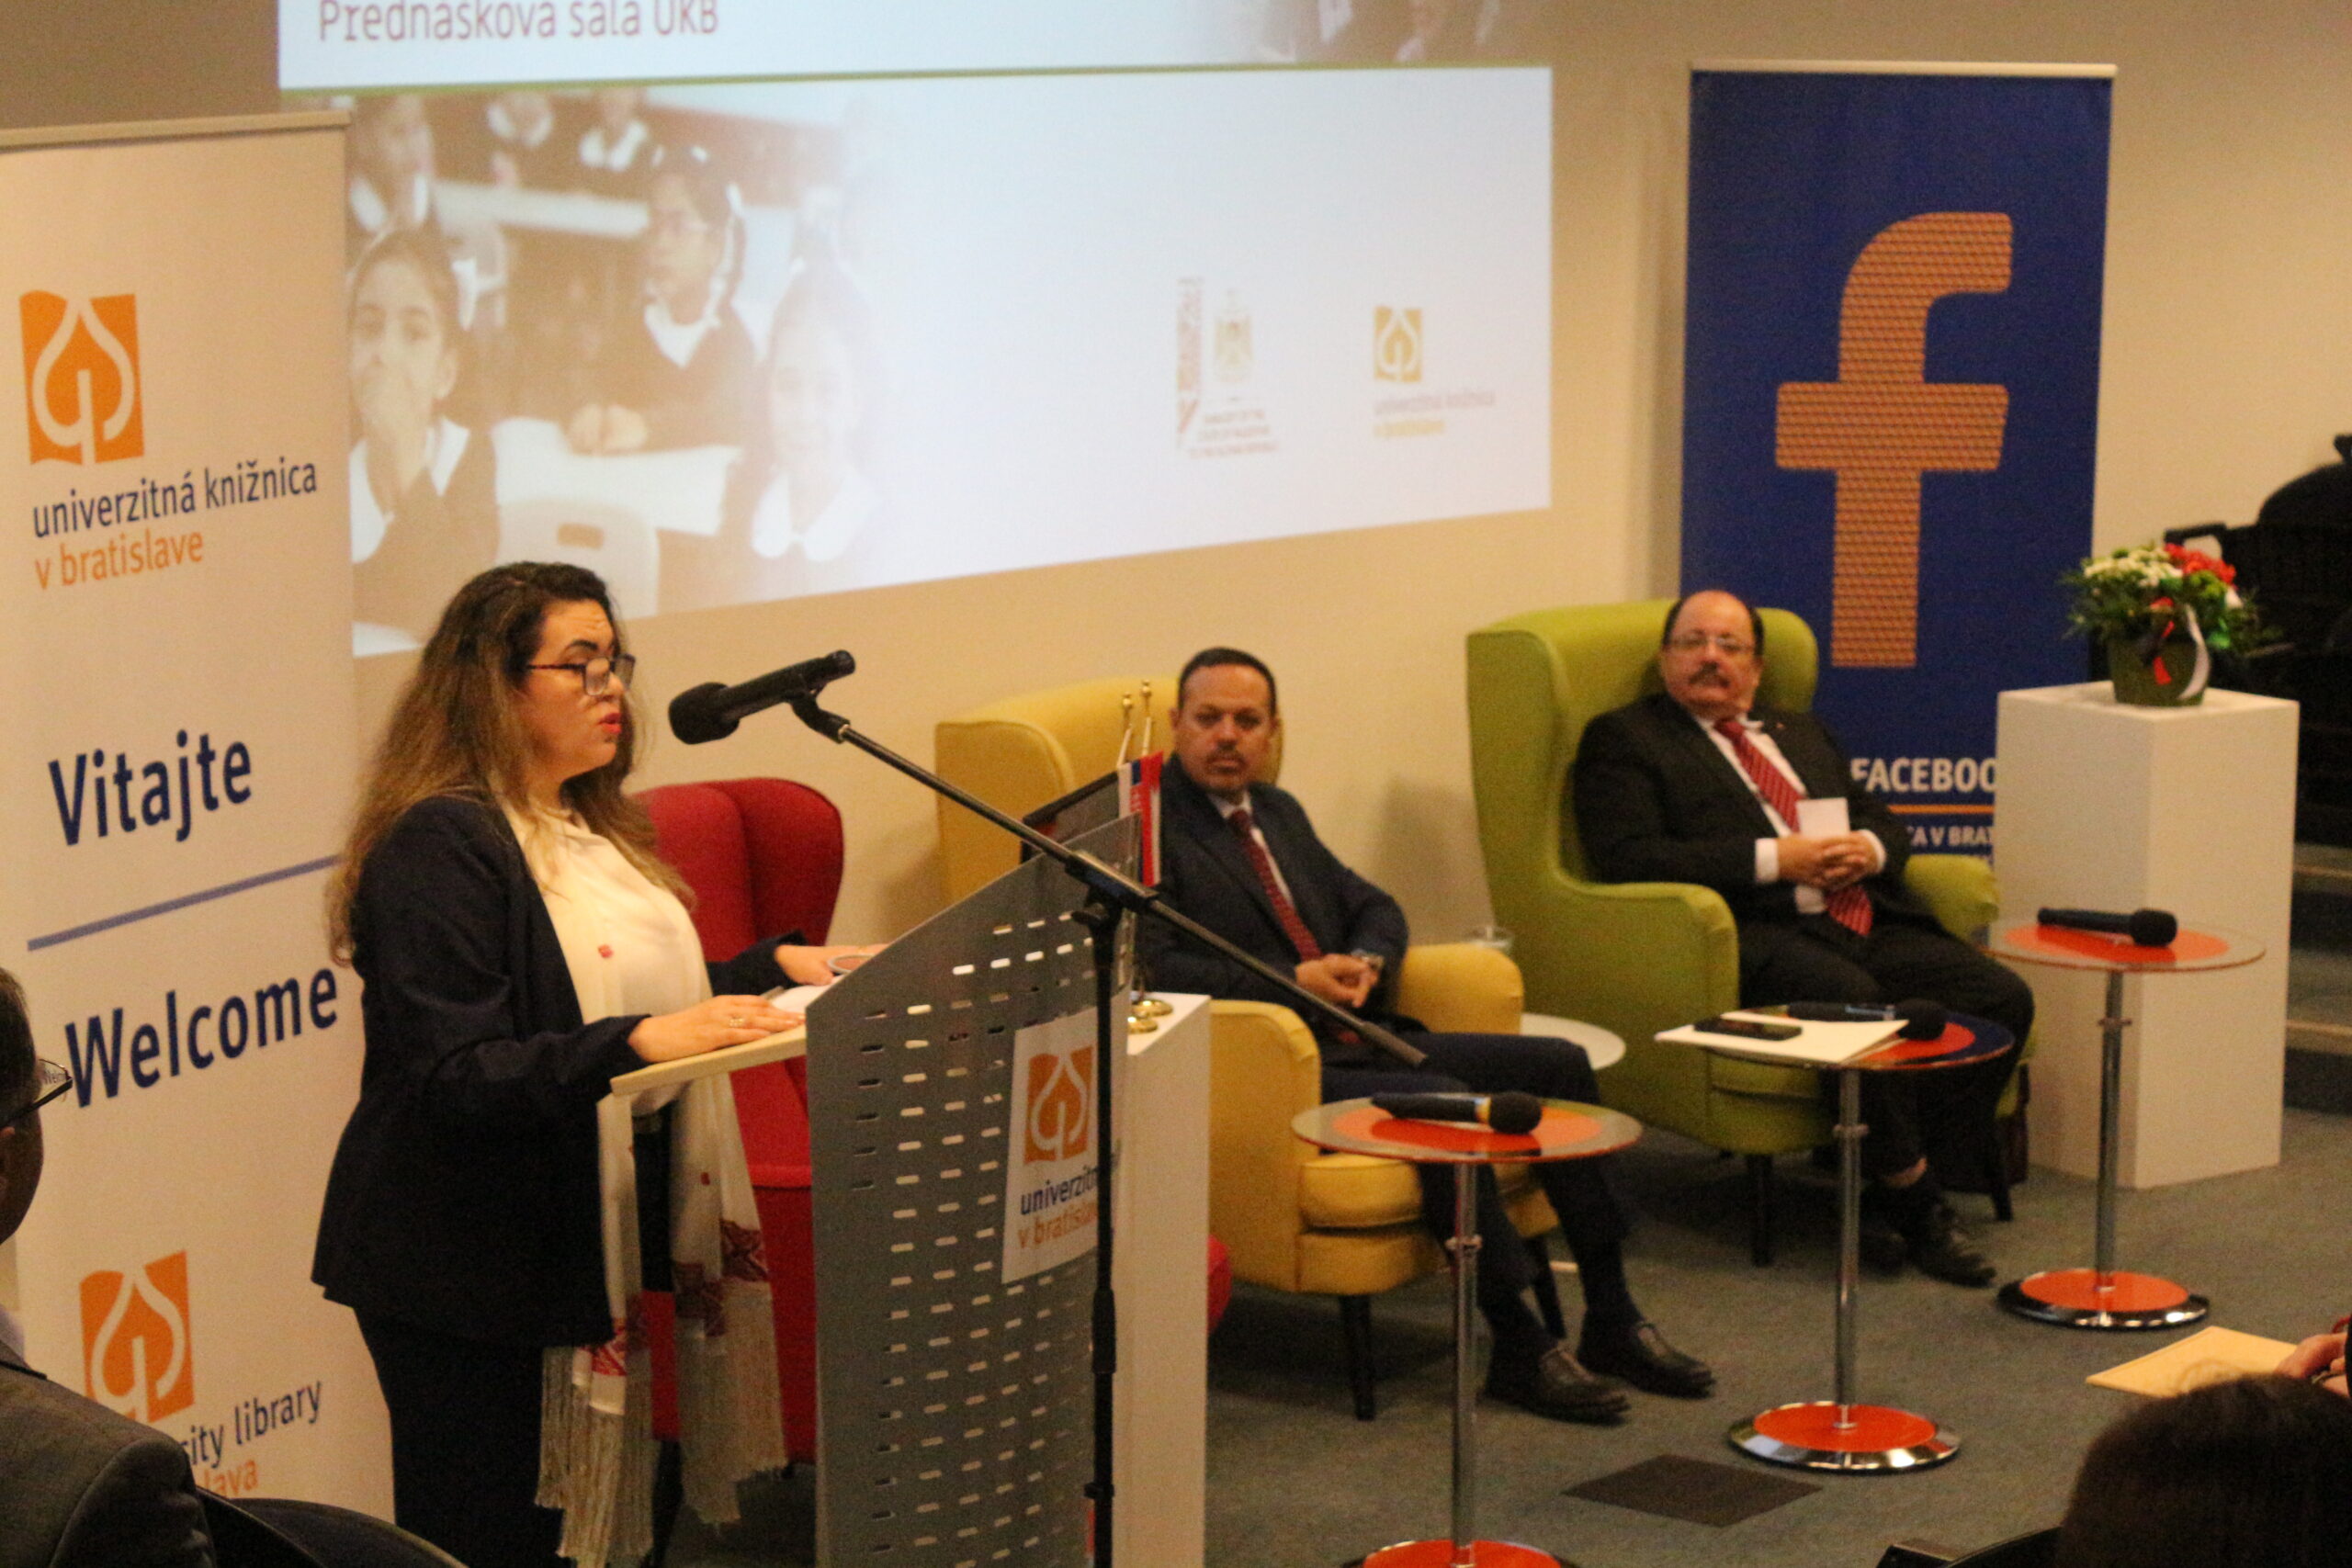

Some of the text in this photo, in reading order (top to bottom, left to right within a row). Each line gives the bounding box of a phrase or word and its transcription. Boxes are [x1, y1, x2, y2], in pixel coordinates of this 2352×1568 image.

[33, 456, 318, 538] univerzitná knižnica
[35, 528, 204, 591] v bratislave
[49, 729, 252, 846] Vitajte
[65, 968, 337, 1108] Welcome
[234, 1381, 322, 1445] library
